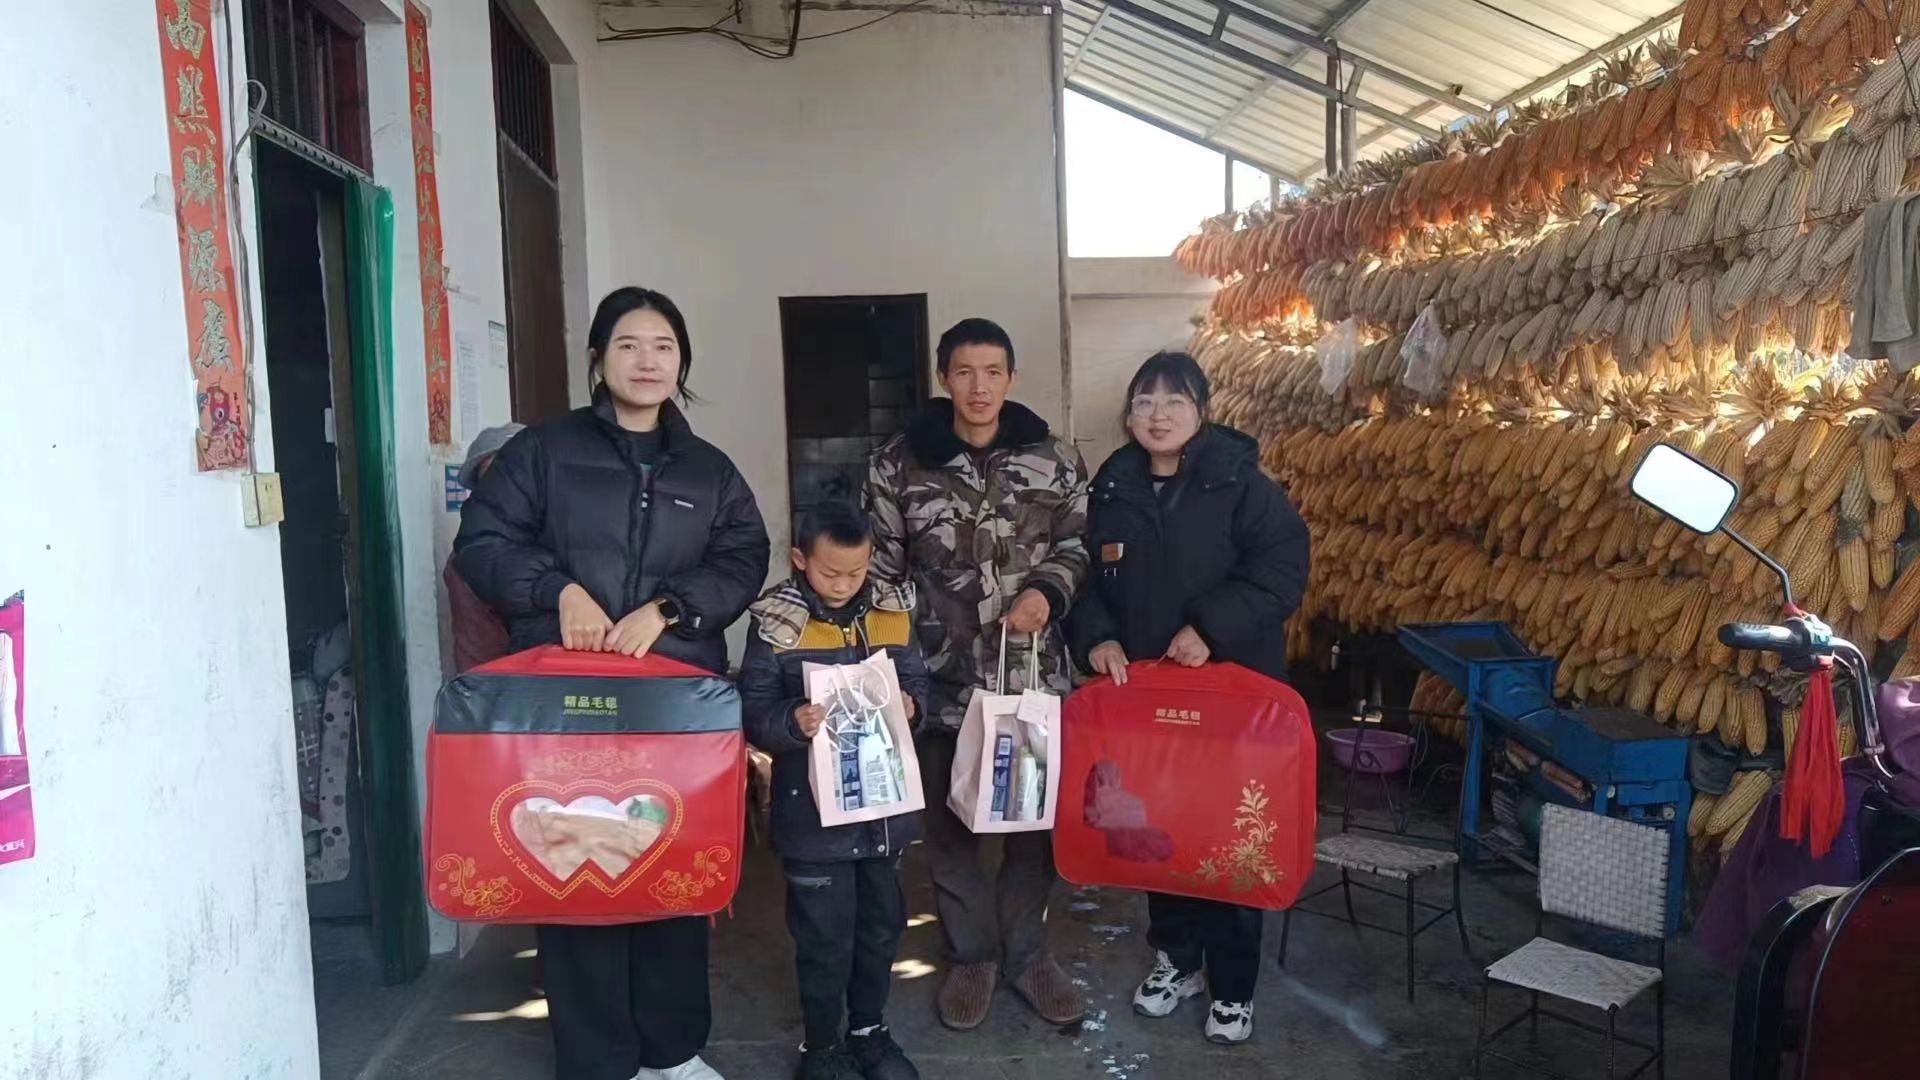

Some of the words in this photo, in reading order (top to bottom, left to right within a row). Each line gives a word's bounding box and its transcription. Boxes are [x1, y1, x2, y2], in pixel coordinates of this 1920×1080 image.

[564, 694, 617, 709] 精品毛毯
[1156, 708, 1200, 721] 精品毛毯
